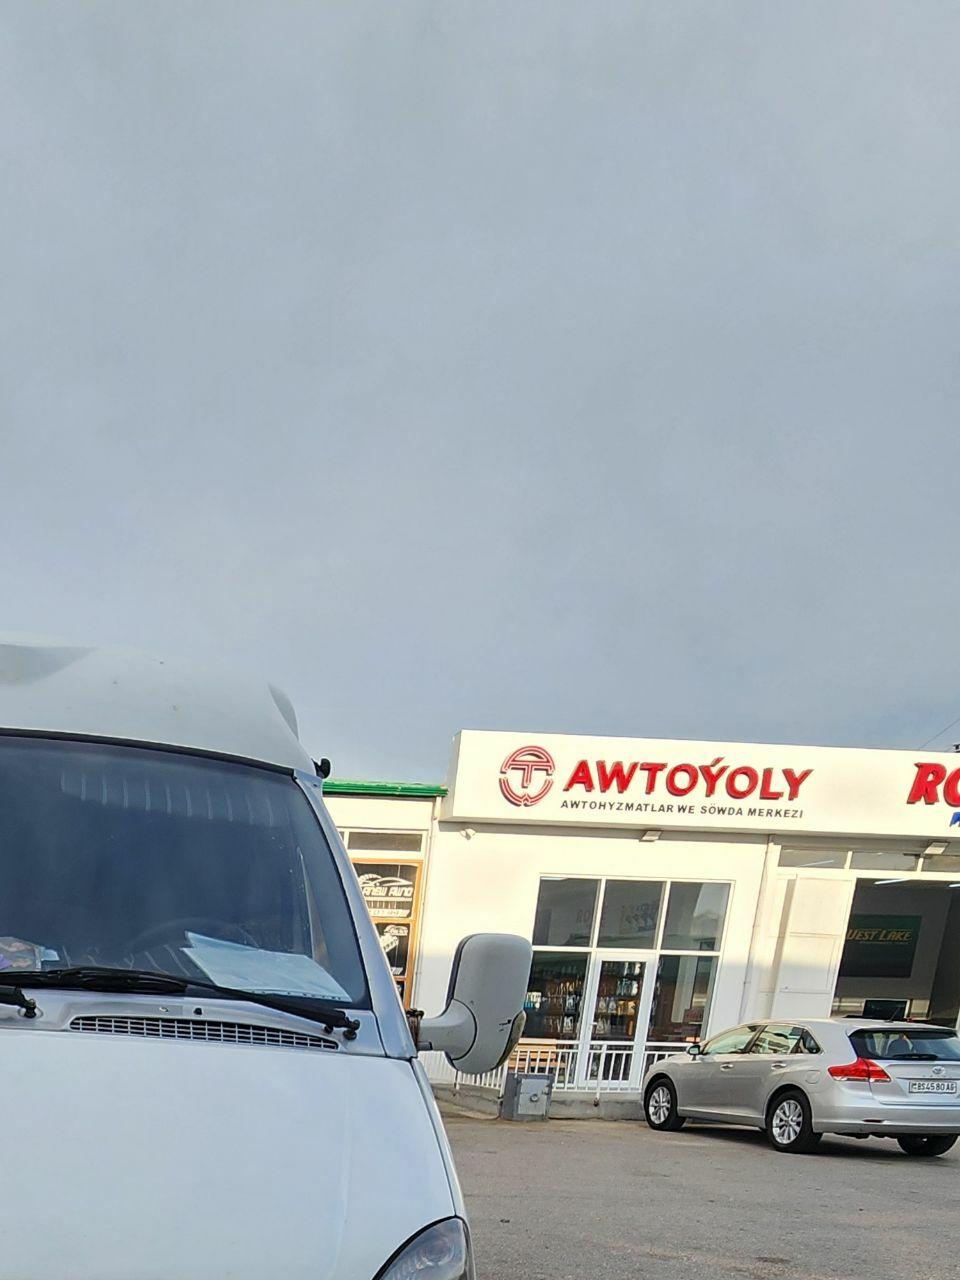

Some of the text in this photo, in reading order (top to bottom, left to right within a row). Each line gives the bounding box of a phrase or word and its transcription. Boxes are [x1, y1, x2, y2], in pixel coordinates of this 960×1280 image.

[563, 757, 814, 801] AWTOÝOLY
[560, 800, 804, 819] AWTOHYZMATLAR WE SÖWDA MERKEZI
